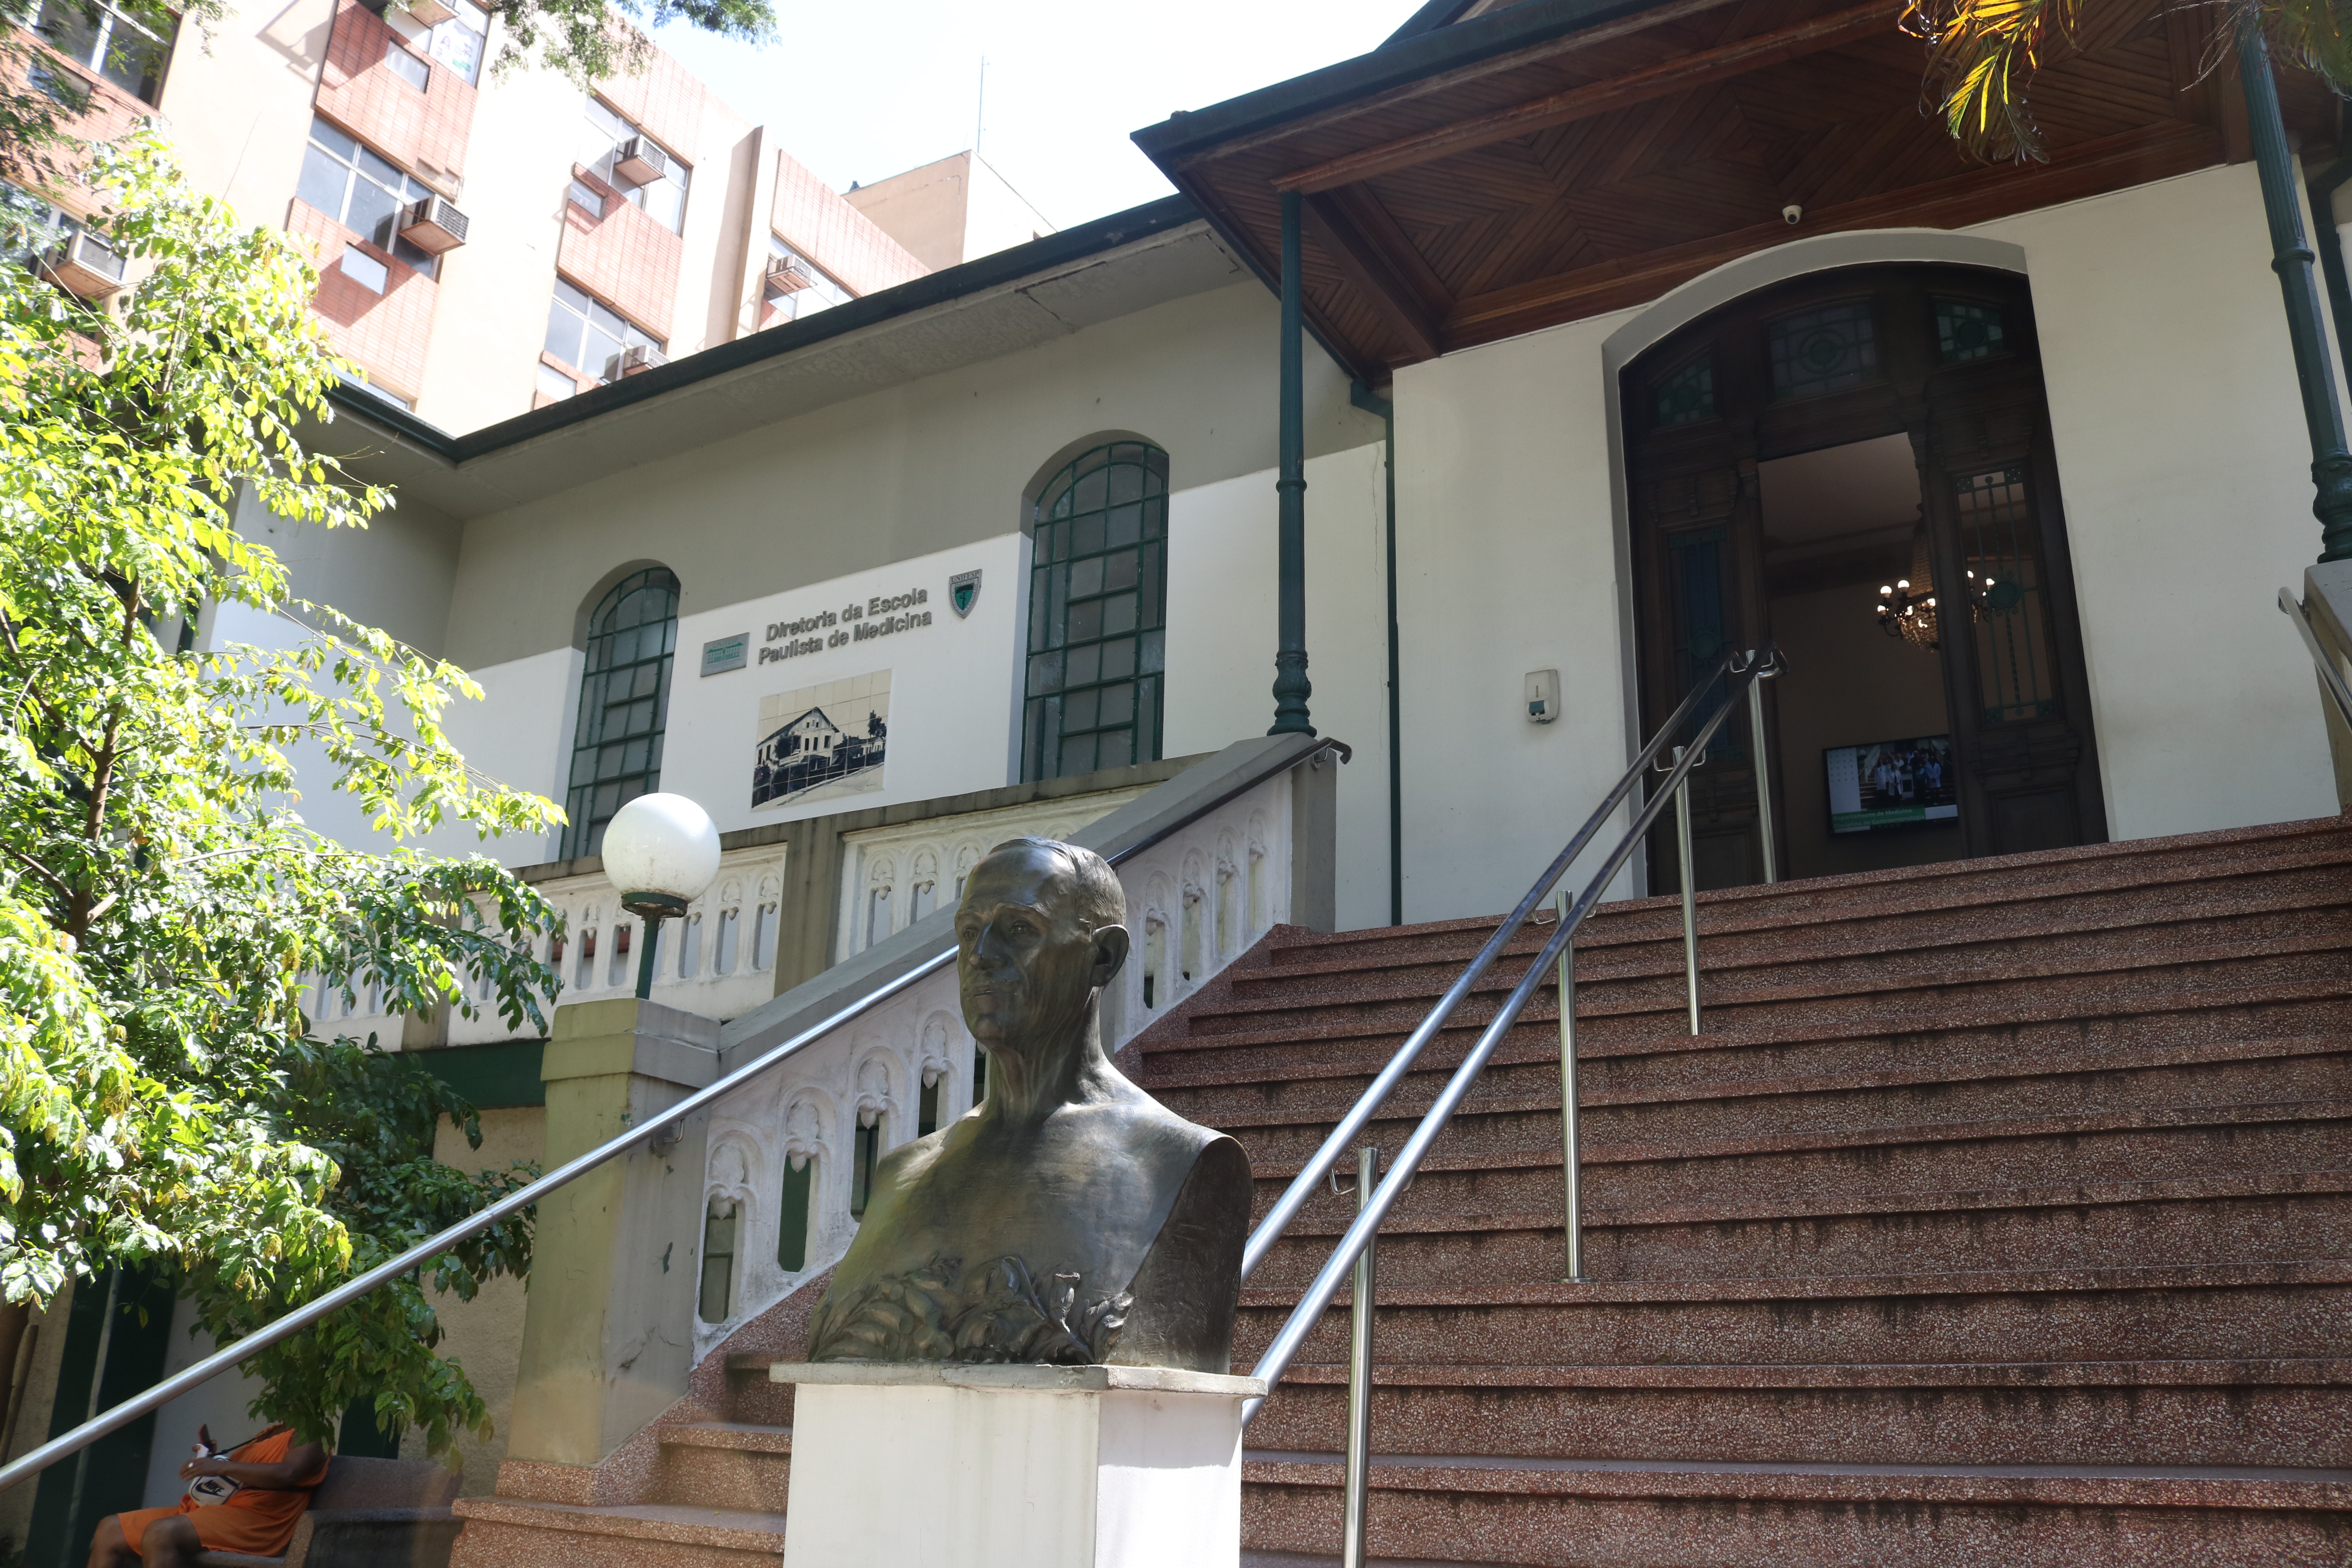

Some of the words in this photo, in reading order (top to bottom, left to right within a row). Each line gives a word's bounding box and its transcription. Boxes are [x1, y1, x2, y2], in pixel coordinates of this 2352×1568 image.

[951, 570, 979, 583] UNIFESP
[766, 610, 837, 641] Diretoria
[841, 604, 863, 622] da
[868, 588, 927, 616] Escola
[713, 637, 739, 648] UNIFESP
[759, 637, 823, 665] Paulista
[828, 629, 849, 648] de
[853, 611, 932, 642] Medicina
[1834, 813, 1876, 821] Departamento
[1872, 815, 1925, 825] Gastroenterologia
[203, 1479, 225, 1494] NIKE
